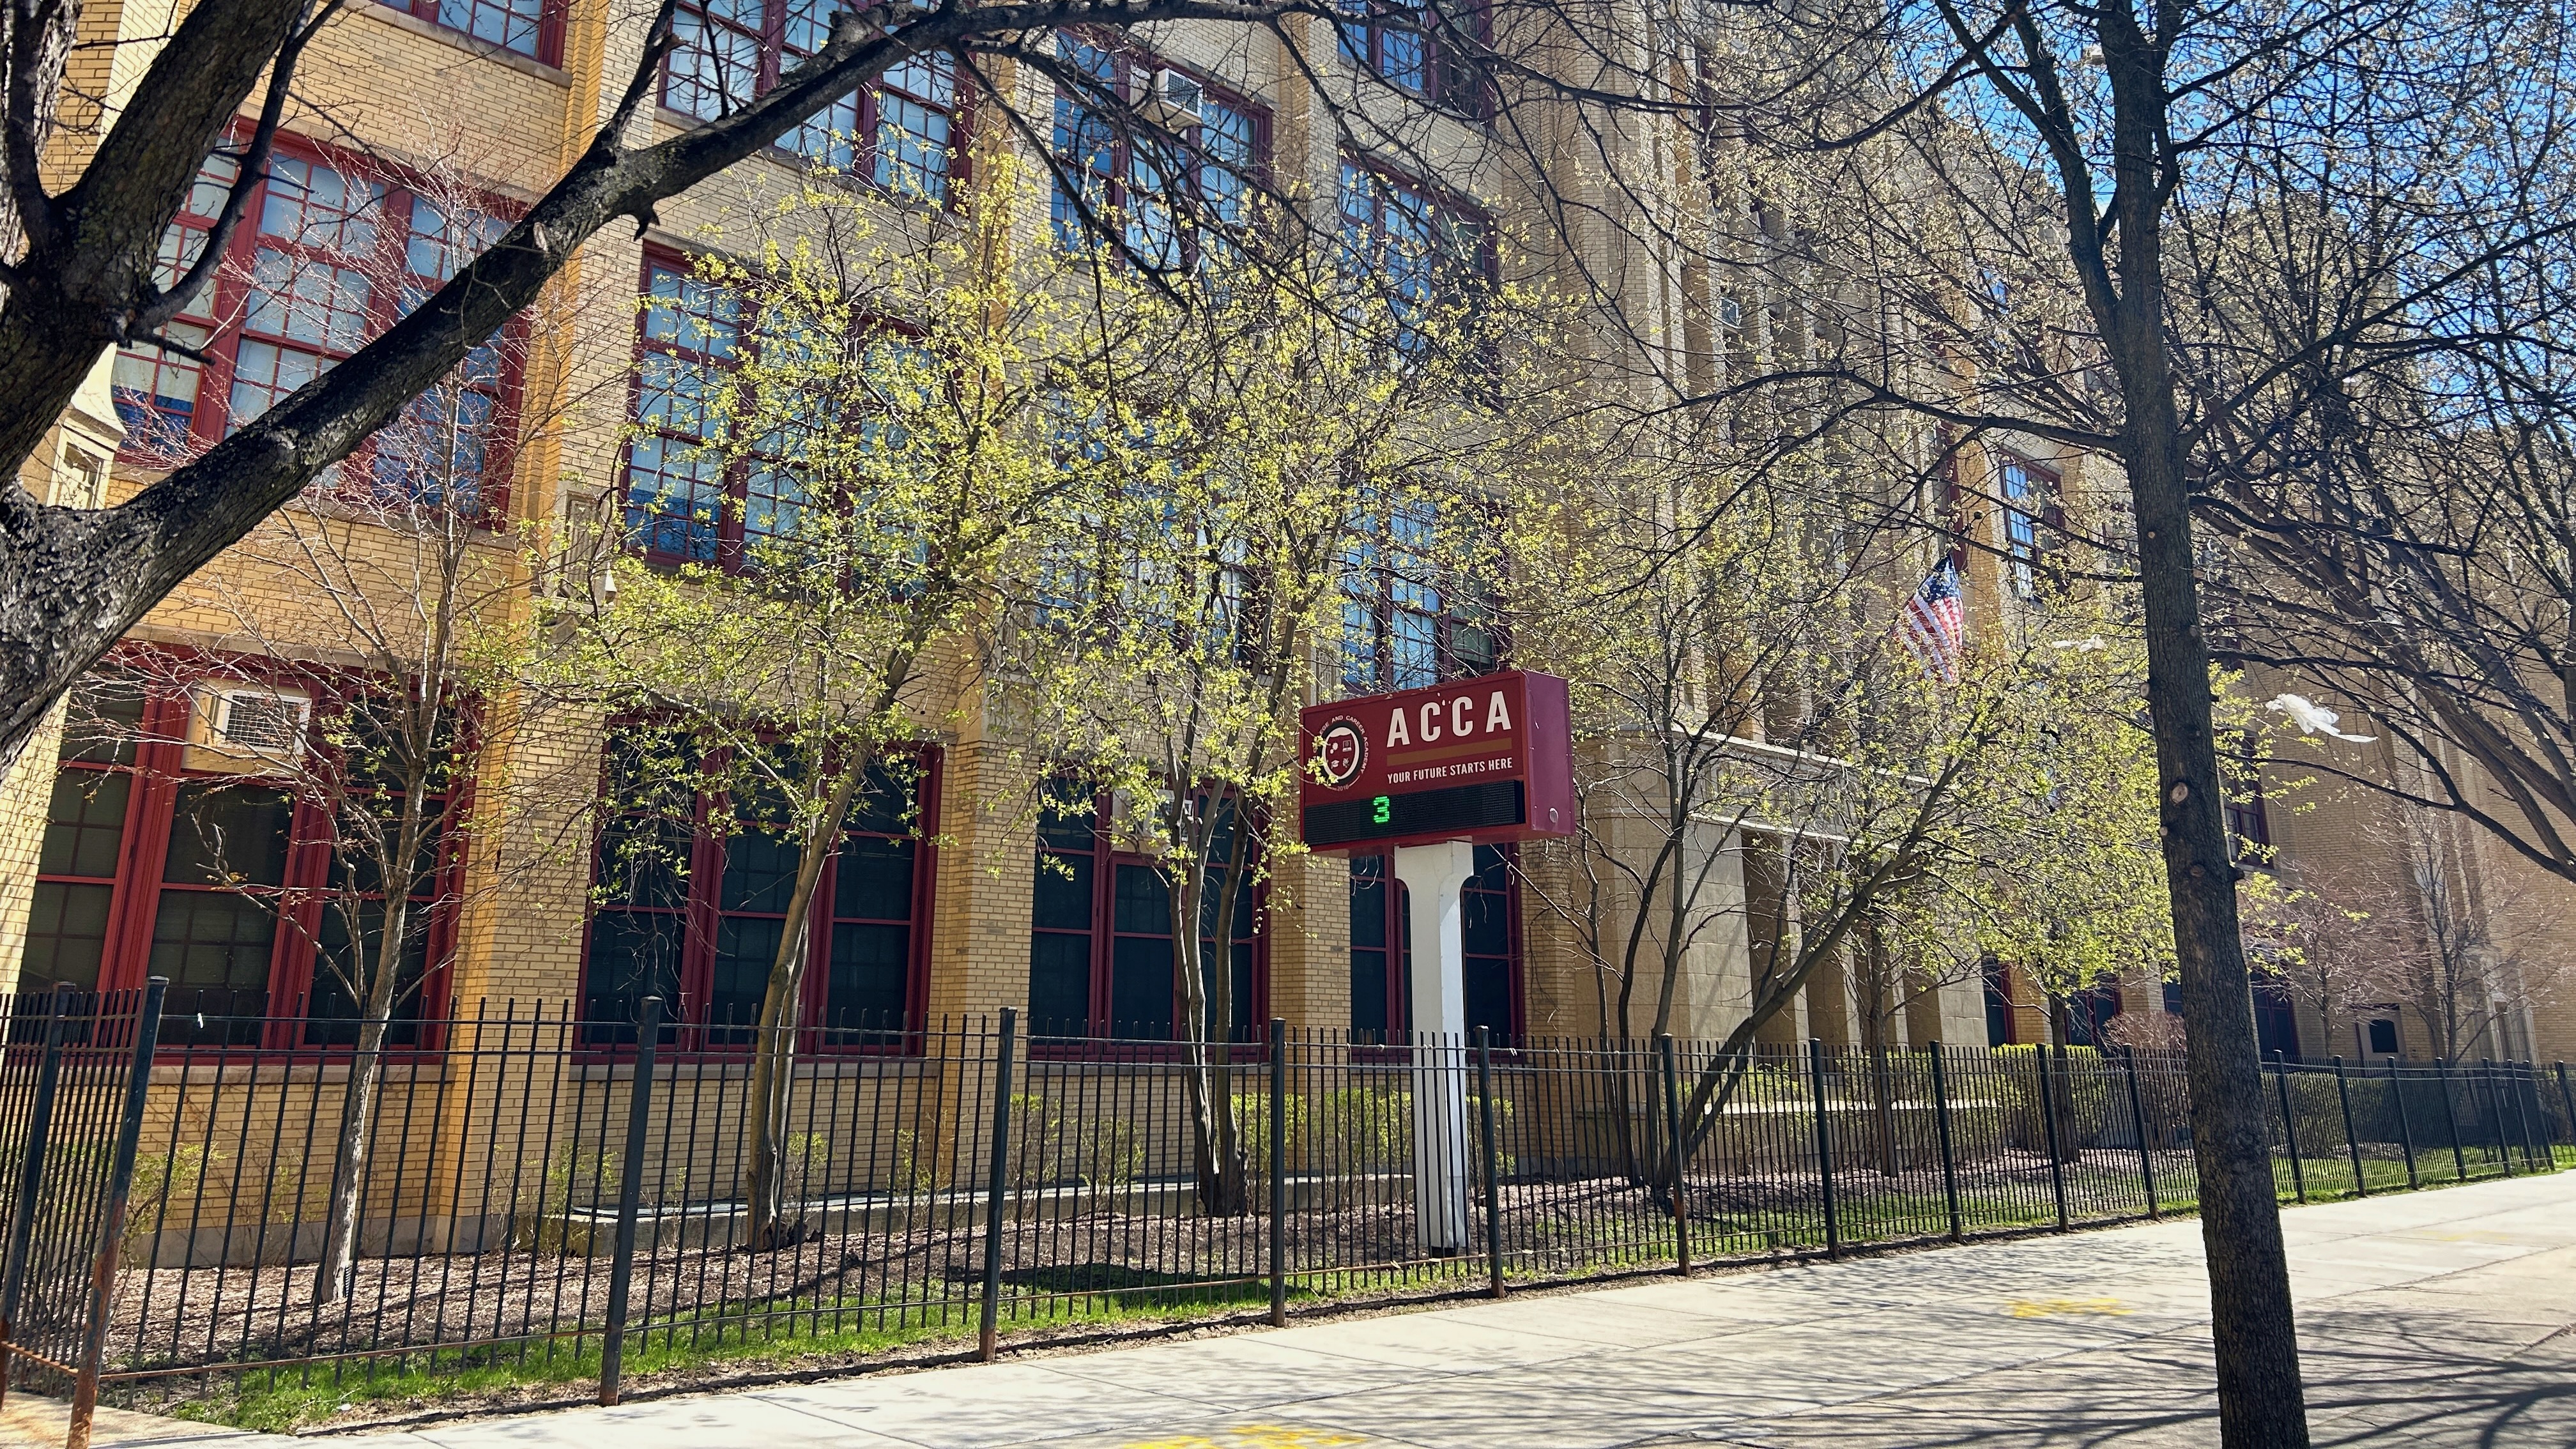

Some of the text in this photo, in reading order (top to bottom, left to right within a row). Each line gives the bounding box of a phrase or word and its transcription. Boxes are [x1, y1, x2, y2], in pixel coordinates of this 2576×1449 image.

[1387, 691, 1512, 747] ACCA
[1346, 716, 1365, 735] CAREER
[1360, 737, 1368, 774] ACADEMY
[1388, 757, 1512, 784] YOUR FUTURE STARTS HERE
[1374, 796, 1390, 823] 3
